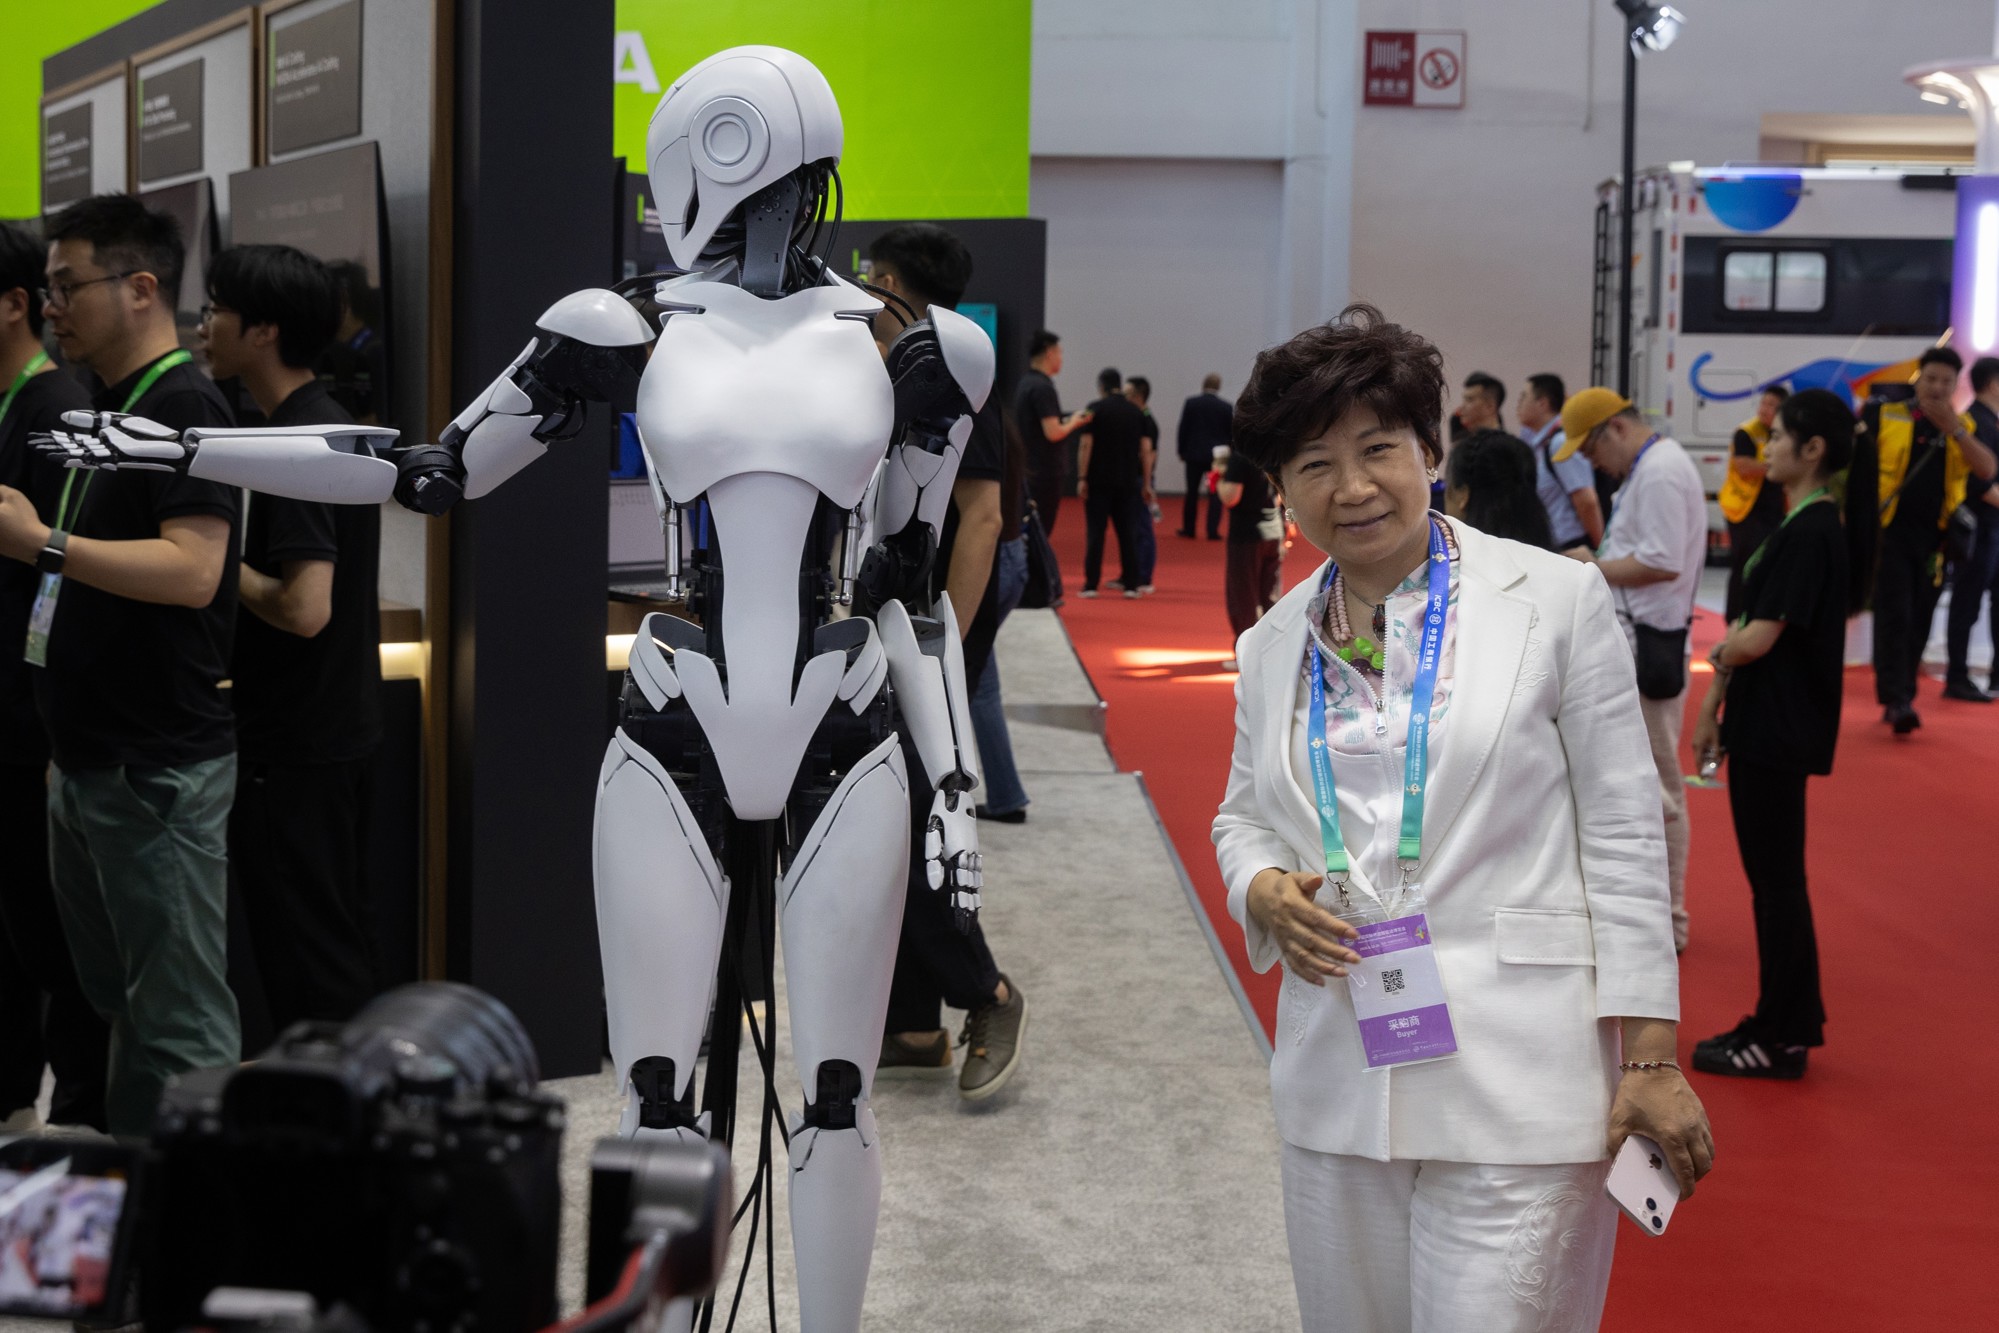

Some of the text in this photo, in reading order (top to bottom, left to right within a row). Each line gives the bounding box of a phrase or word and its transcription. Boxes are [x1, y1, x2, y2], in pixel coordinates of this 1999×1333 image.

[1433, 595, 1442, 612] ICBC
[1388, 1015, 1420, 1031] 采购商
[1396, 1029, 1418, 1038] Buyer
